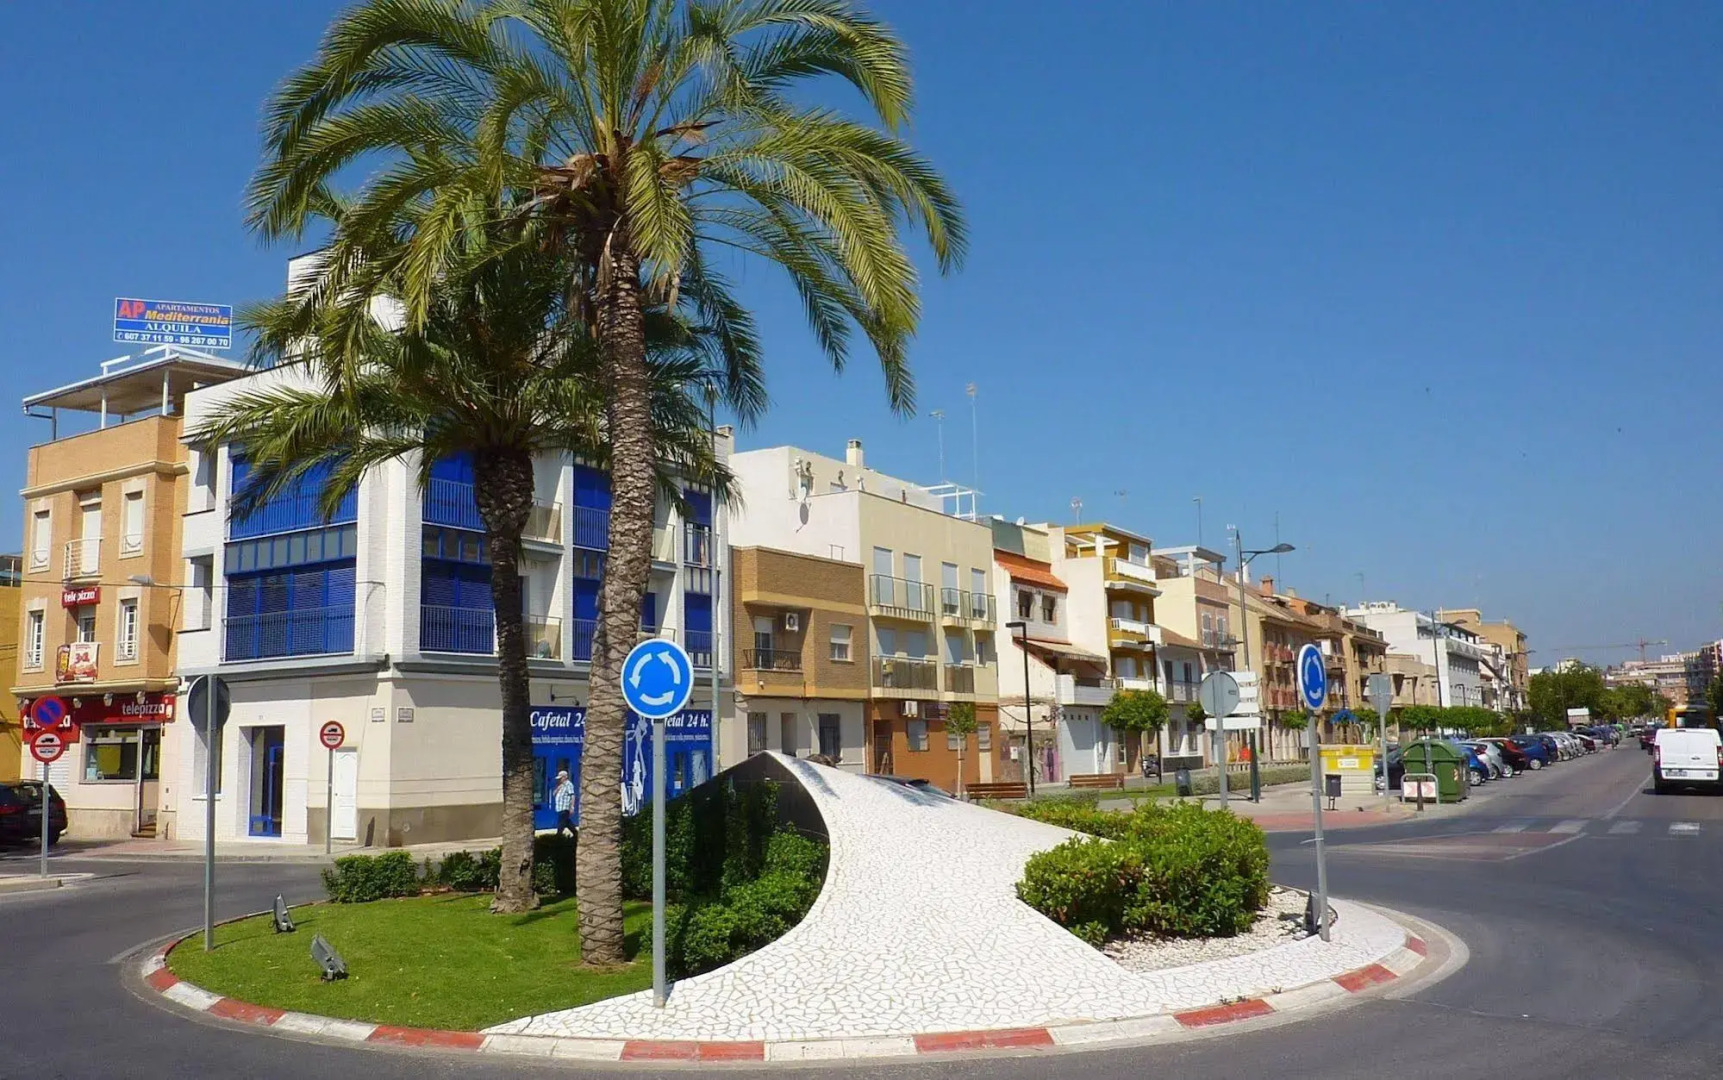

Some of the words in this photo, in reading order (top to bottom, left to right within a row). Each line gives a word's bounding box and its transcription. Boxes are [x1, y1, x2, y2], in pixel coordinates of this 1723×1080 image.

[118, 300, 145, 318] AP
[155, 304, 220, 314] APARTAMENTOS
[144, 310, 229, 325] Mediterrania
[144, 323, 202, 333] ALQUILA
[64, 590, 96, 603] telepizza
[122, 700, 165, 718] telepizza
[530, 711, 571, 731] Cafetal
[687, 713, 699, 727] 24
